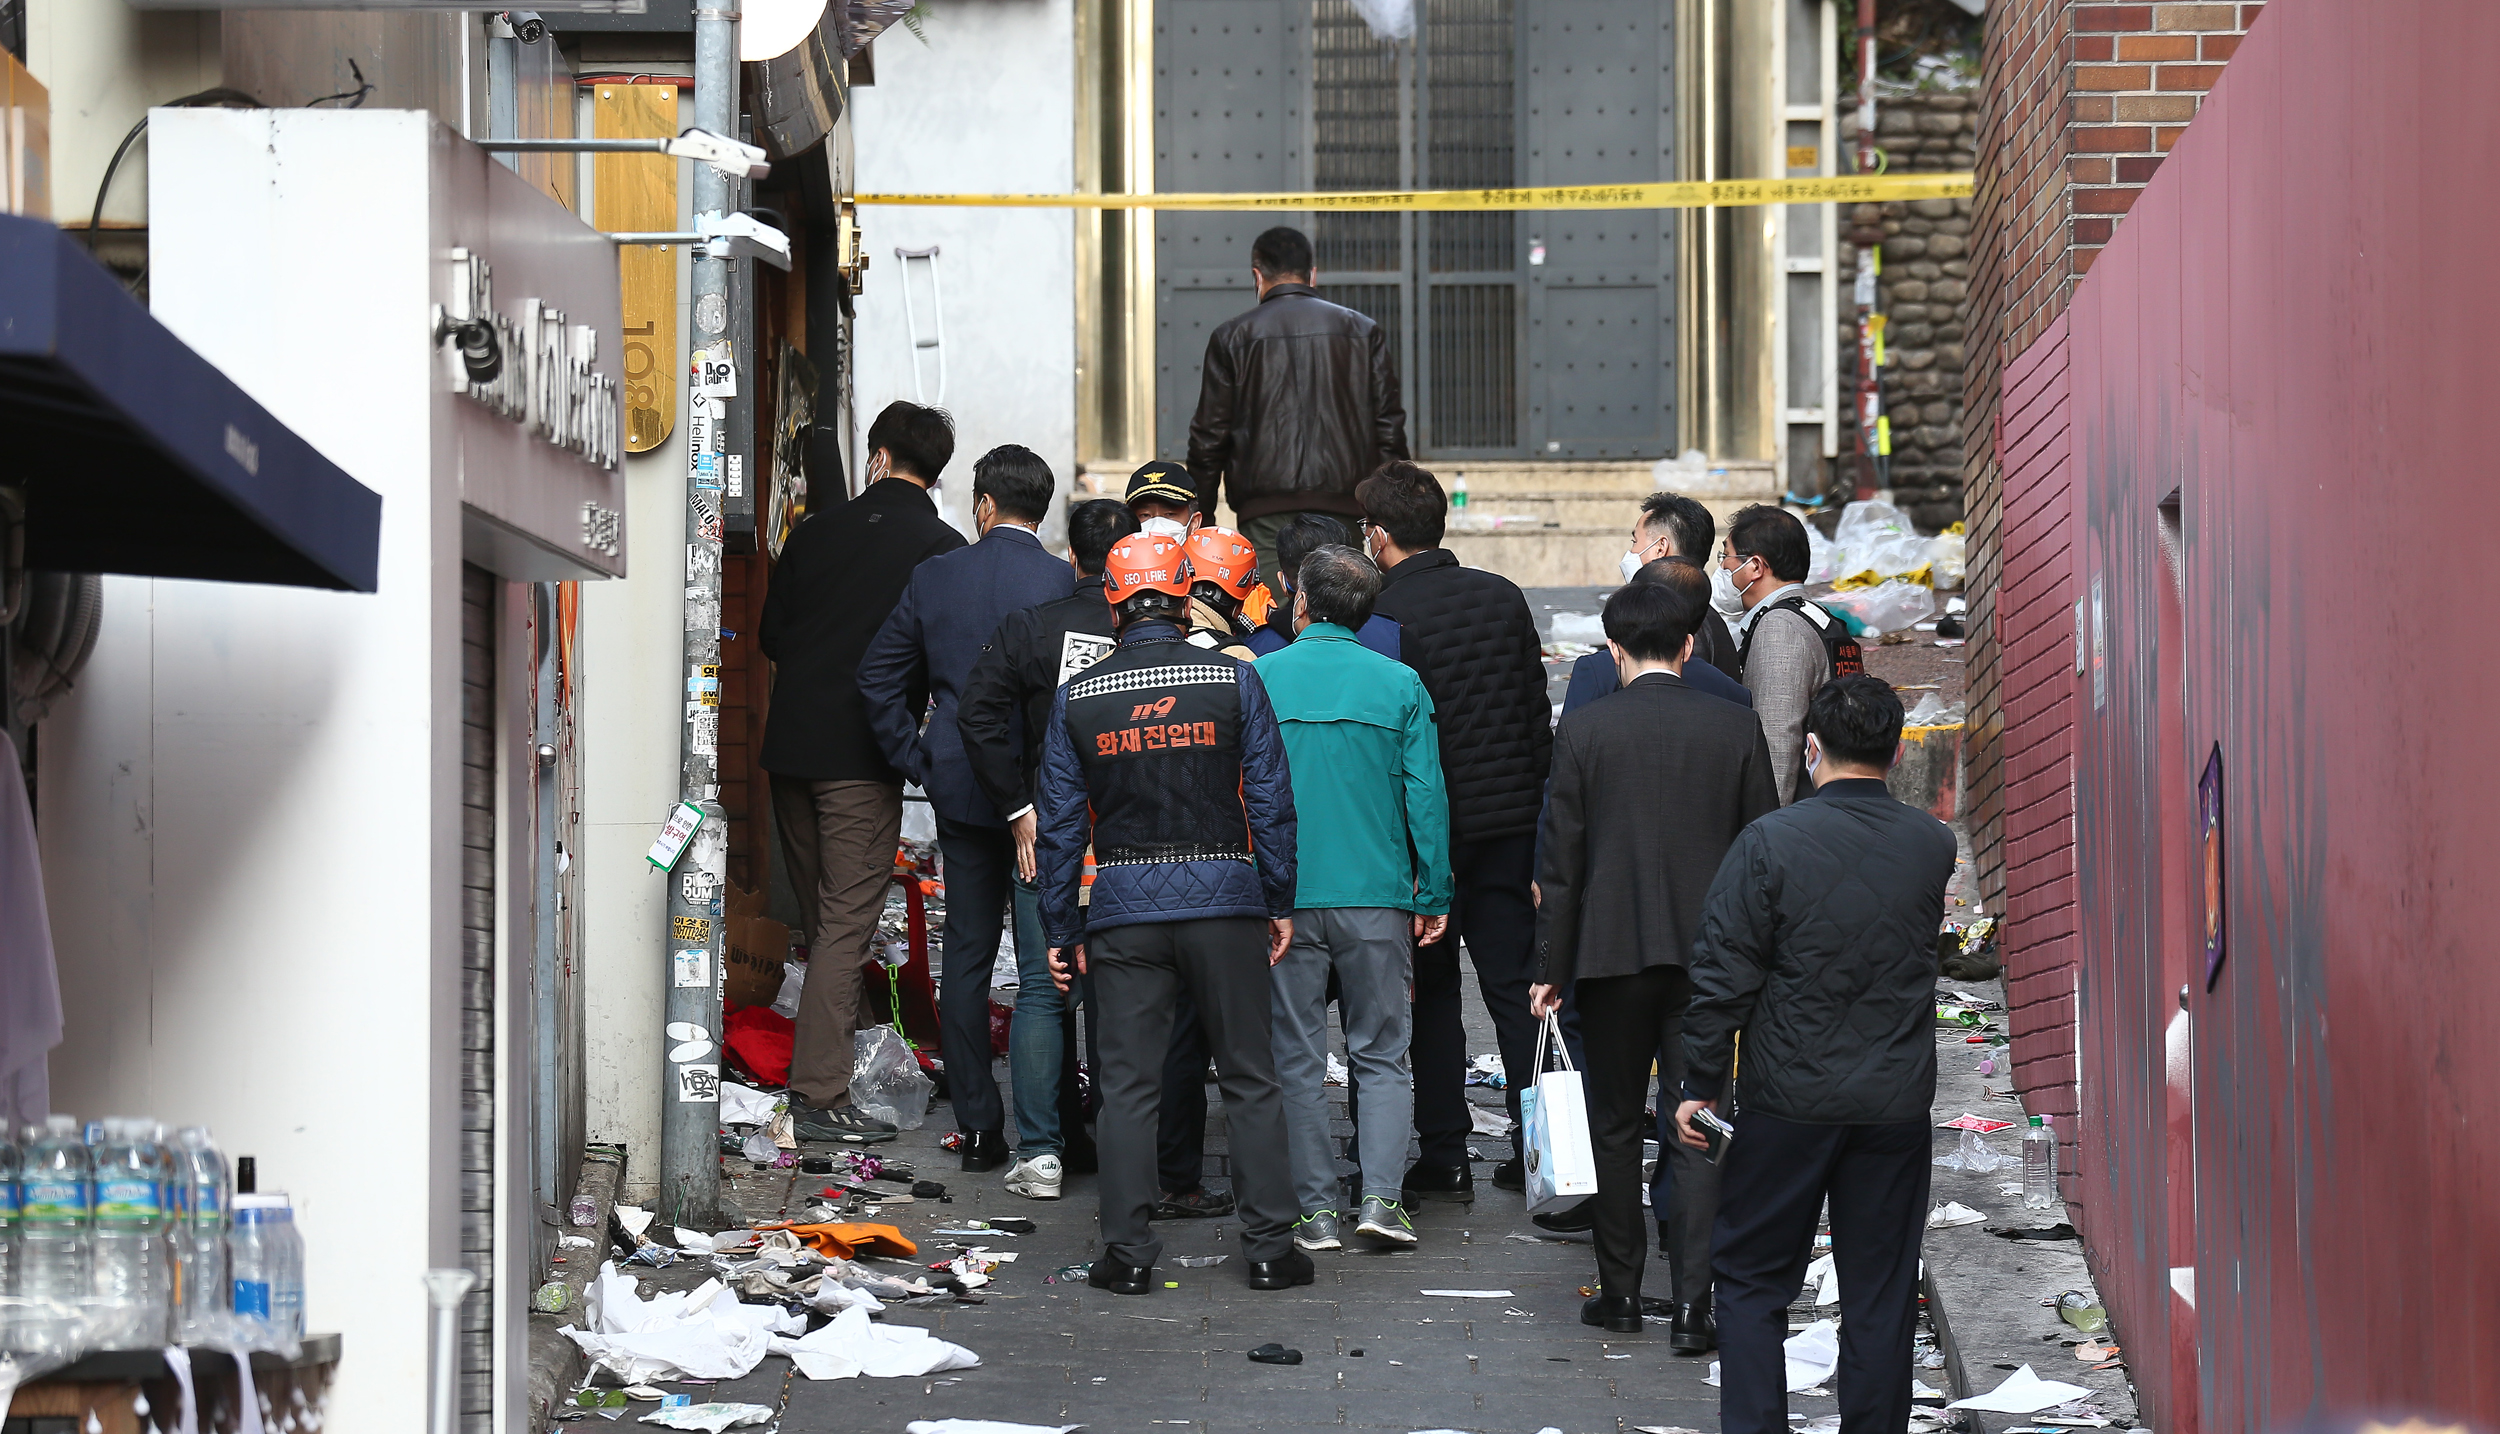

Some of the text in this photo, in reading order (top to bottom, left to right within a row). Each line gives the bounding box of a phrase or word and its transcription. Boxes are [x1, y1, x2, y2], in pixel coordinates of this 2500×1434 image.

[622, 321, 655, 410] 108
[691, 416, 705, 472] Helinox
[690, 493, 716, 525] MALO
[1129, 696, 1177, 721] 119
